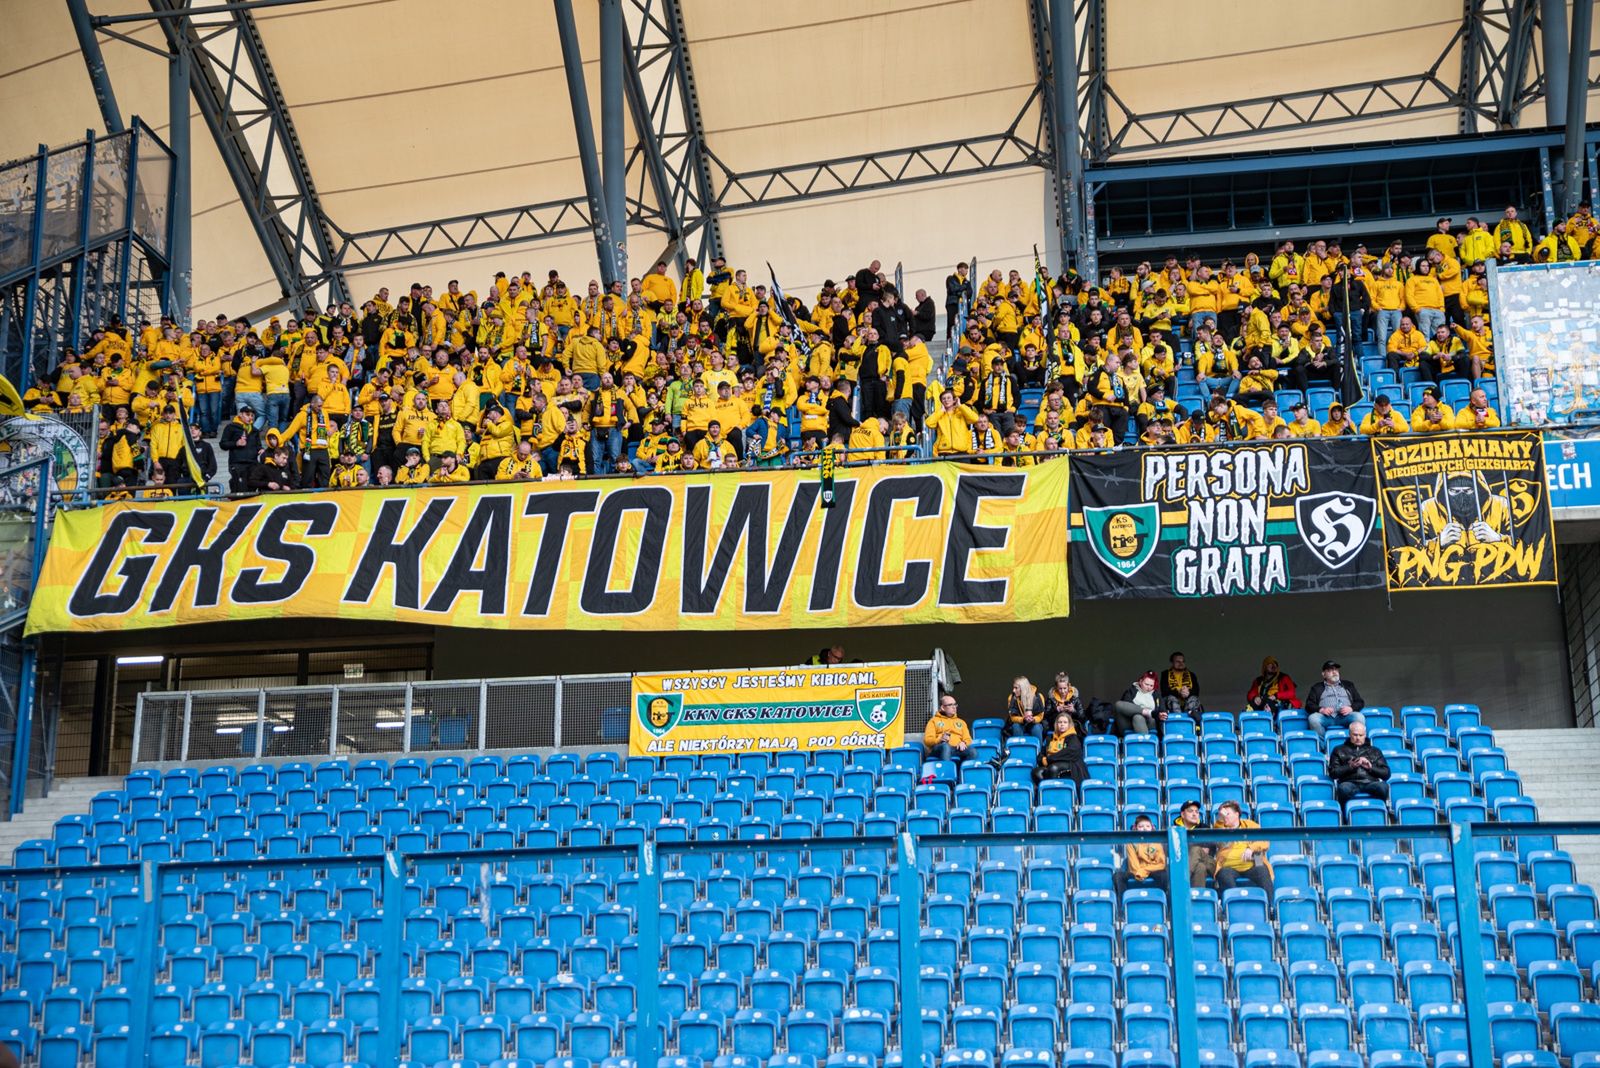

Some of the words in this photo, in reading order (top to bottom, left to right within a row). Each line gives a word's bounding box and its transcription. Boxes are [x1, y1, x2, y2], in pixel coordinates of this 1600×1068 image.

[1382, 439, 1533, 467] POZDRAWIAMY
[1385, 459, 1464, 479] NIEOBECNYCH
[1466, 458, 1536, 471] GIEKSIARZY
[1144, 447, 1307, 500] PERSONA
[1188, 496, 1267, 546] NON
[69, 501, 339, 617] GKS
[341, 472, 1028, 617] KATOWICE
[1391, 536, 1471, 585] PNG
[1467, 533, 1546, 585] PDW
[1175, 545, 1287, 595] GRATA
[662, 677, 726, 691] WSZYSCY
[733, 671, 805, 689] JESTEŚMY
[811, 671, 878, 687] KIBICAMI,
[683, 707, 721, 722] KKN
[722, 706, 759, 721] GKS
[760, 704, 854, 720] KATOWICE
[647, 738, 674, 752] ALE
[679, 735, 754, 751] NIEKTÓRZY
[757, 736, 798, 750] MAJĄ
[808, 735, 835, 748] POD
[840, 731, 886, 748] GÓRKĘ
